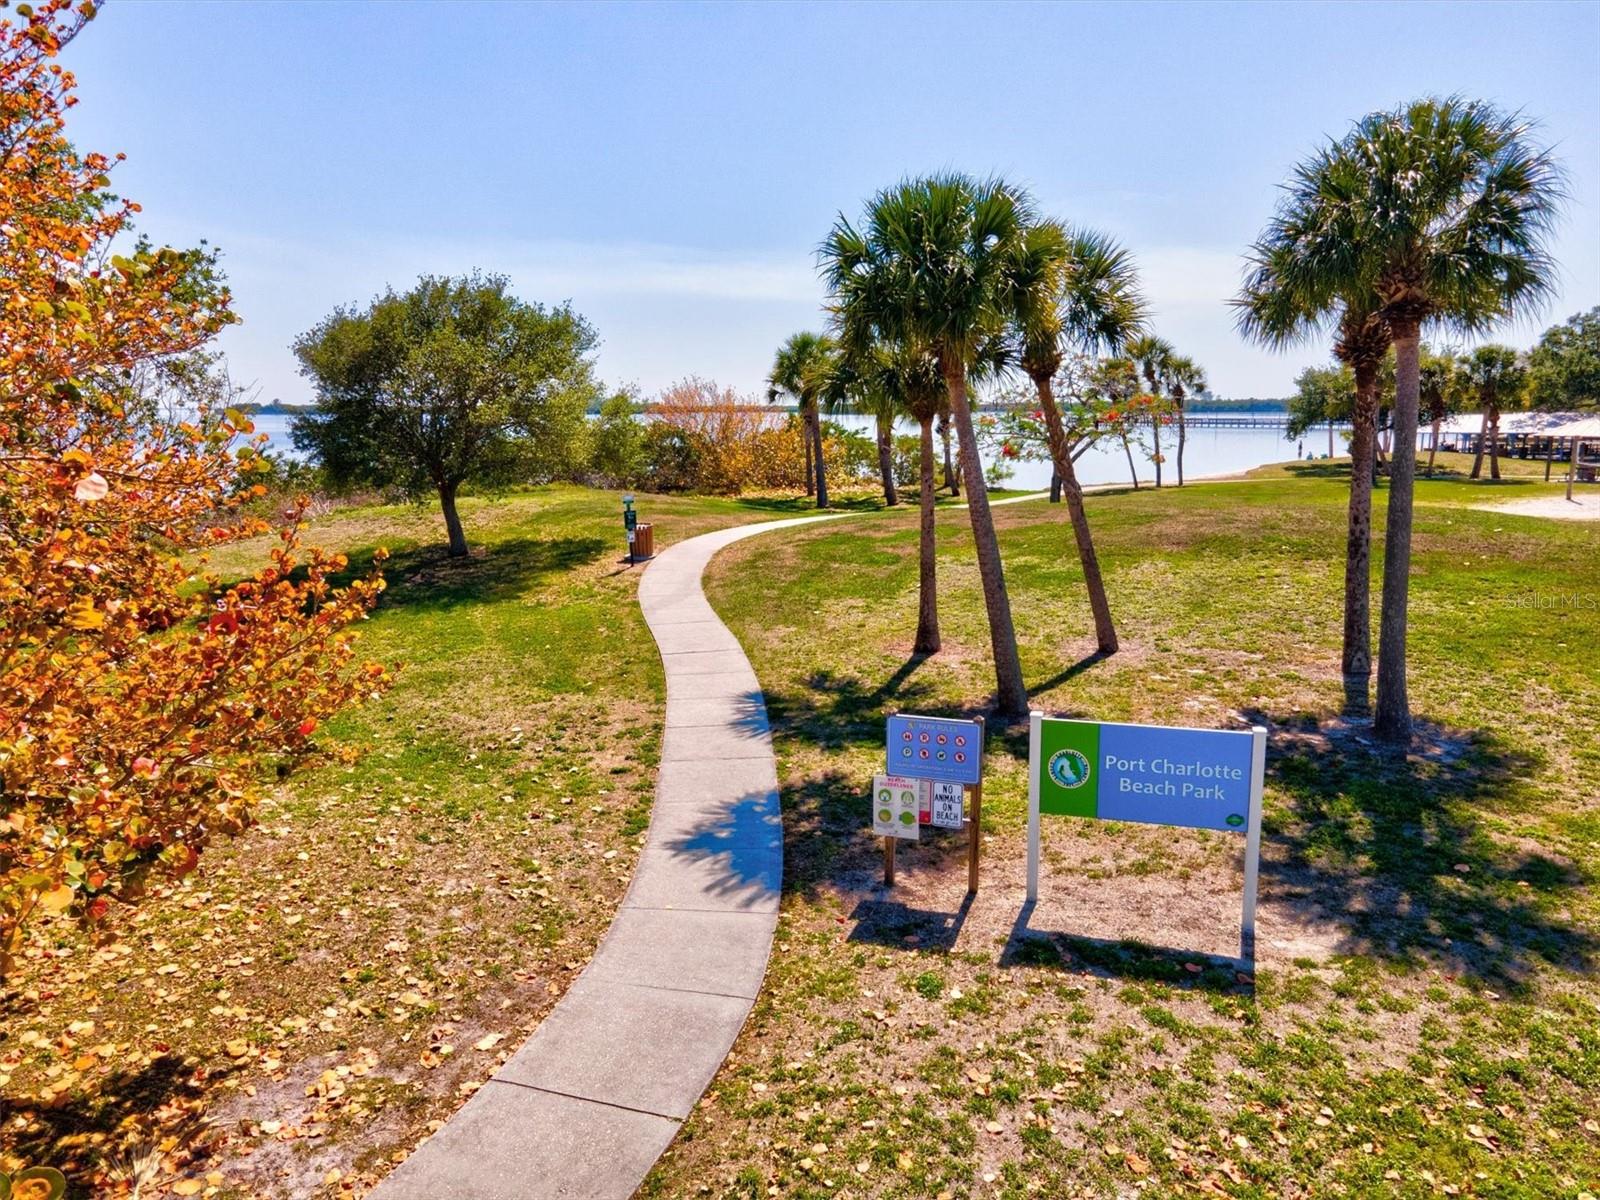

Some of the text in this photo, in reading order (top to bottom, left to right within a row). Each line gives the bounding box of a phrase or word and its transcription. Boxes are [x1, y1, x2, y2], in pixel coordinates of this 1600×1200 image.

[1105, 755, 1145, 773] Port
[1151, 758, 1242, 780] Charlotte
[942, 785, 953, 793] NO
[1119, 778, 1225, 800] Beach Park
[934, 794, 961, 804] ANIMALS
[942, 803, 953, 812] ON
[936, 811, 959, 821] BEACH
